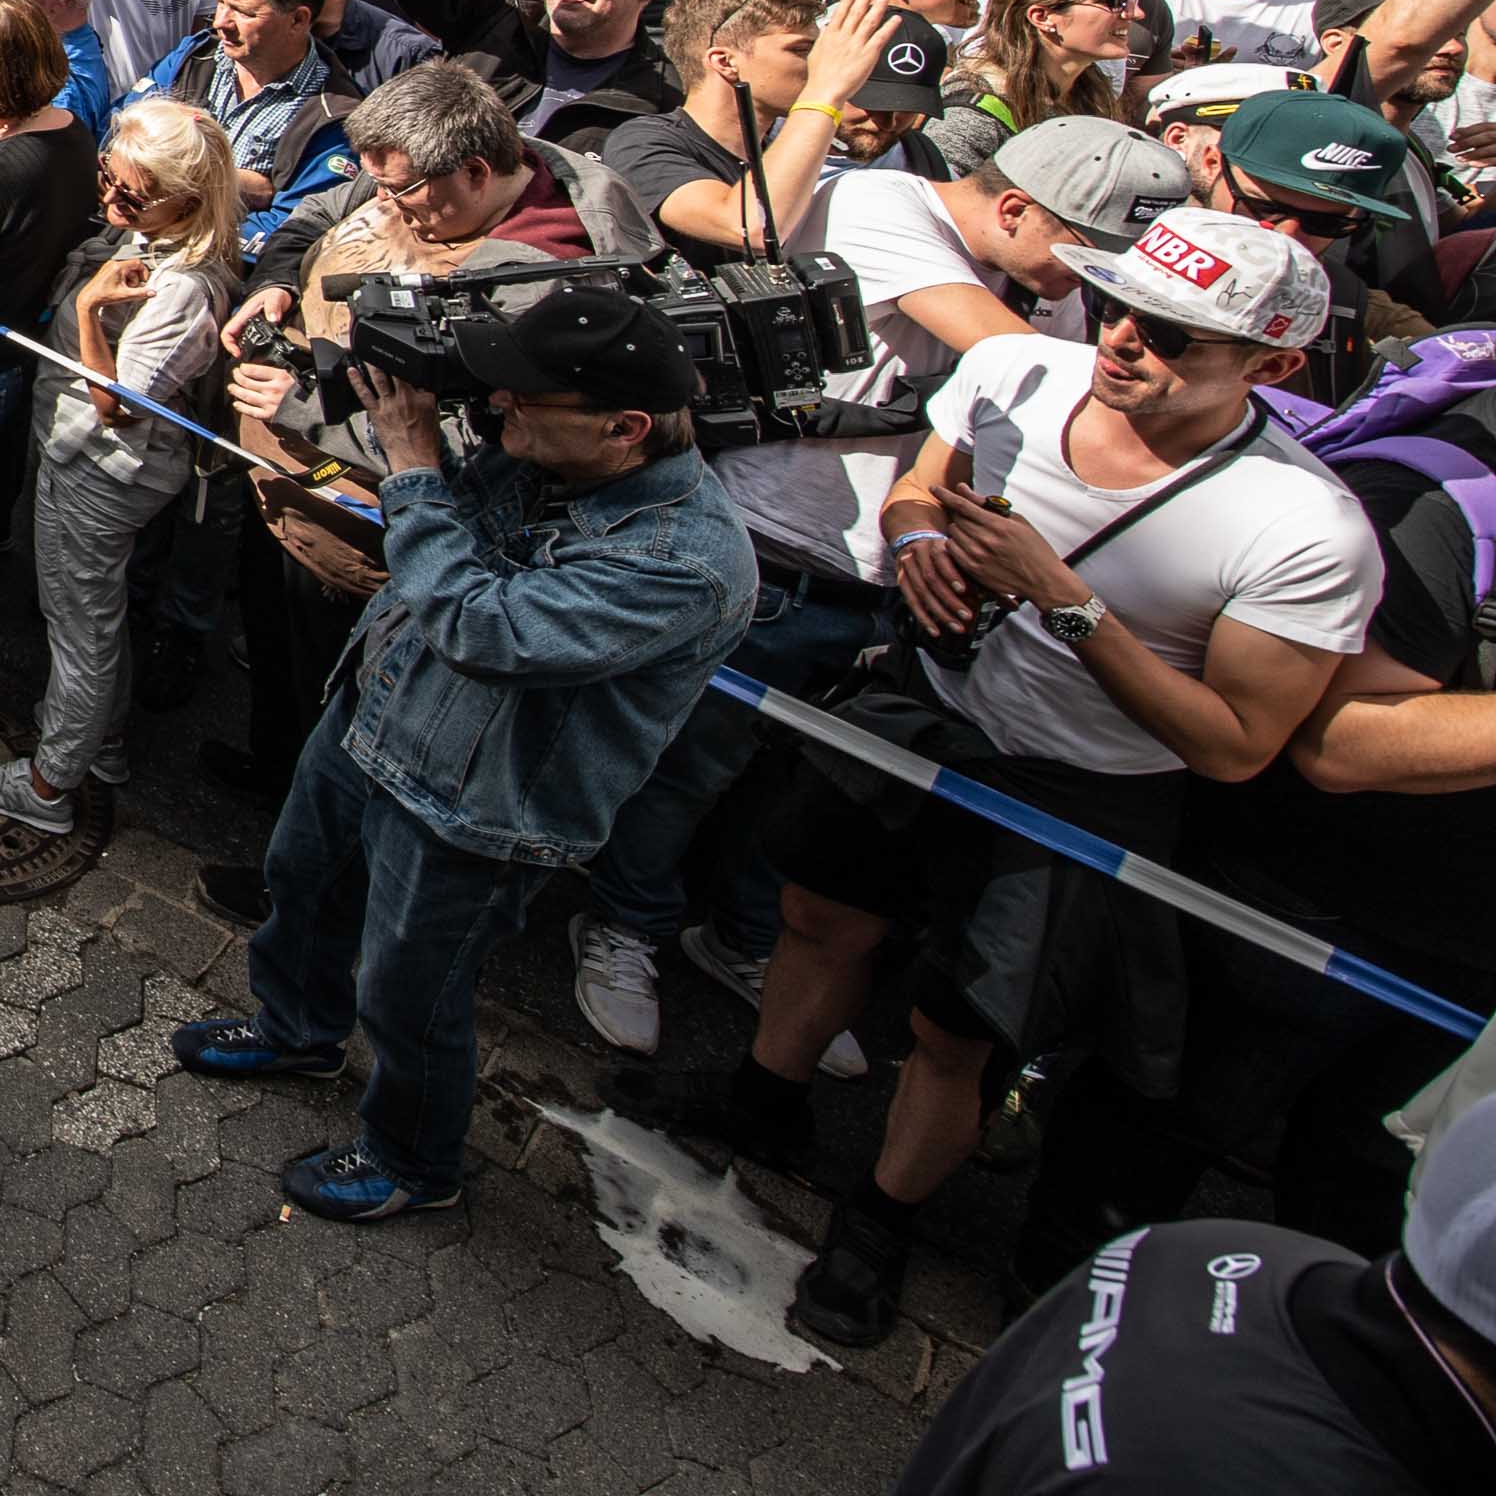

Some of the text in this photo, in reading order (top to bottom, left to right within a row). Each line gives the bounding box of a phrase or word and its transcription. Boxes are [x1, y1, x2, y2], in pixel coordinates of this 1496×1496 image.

[1316, 141, 1373, 166] NIKE
[1142, 225, 1216, 282] NBR
[312, 461, 342, 481] Nikon
[1062, 1280, 1127, 1472] AMG
